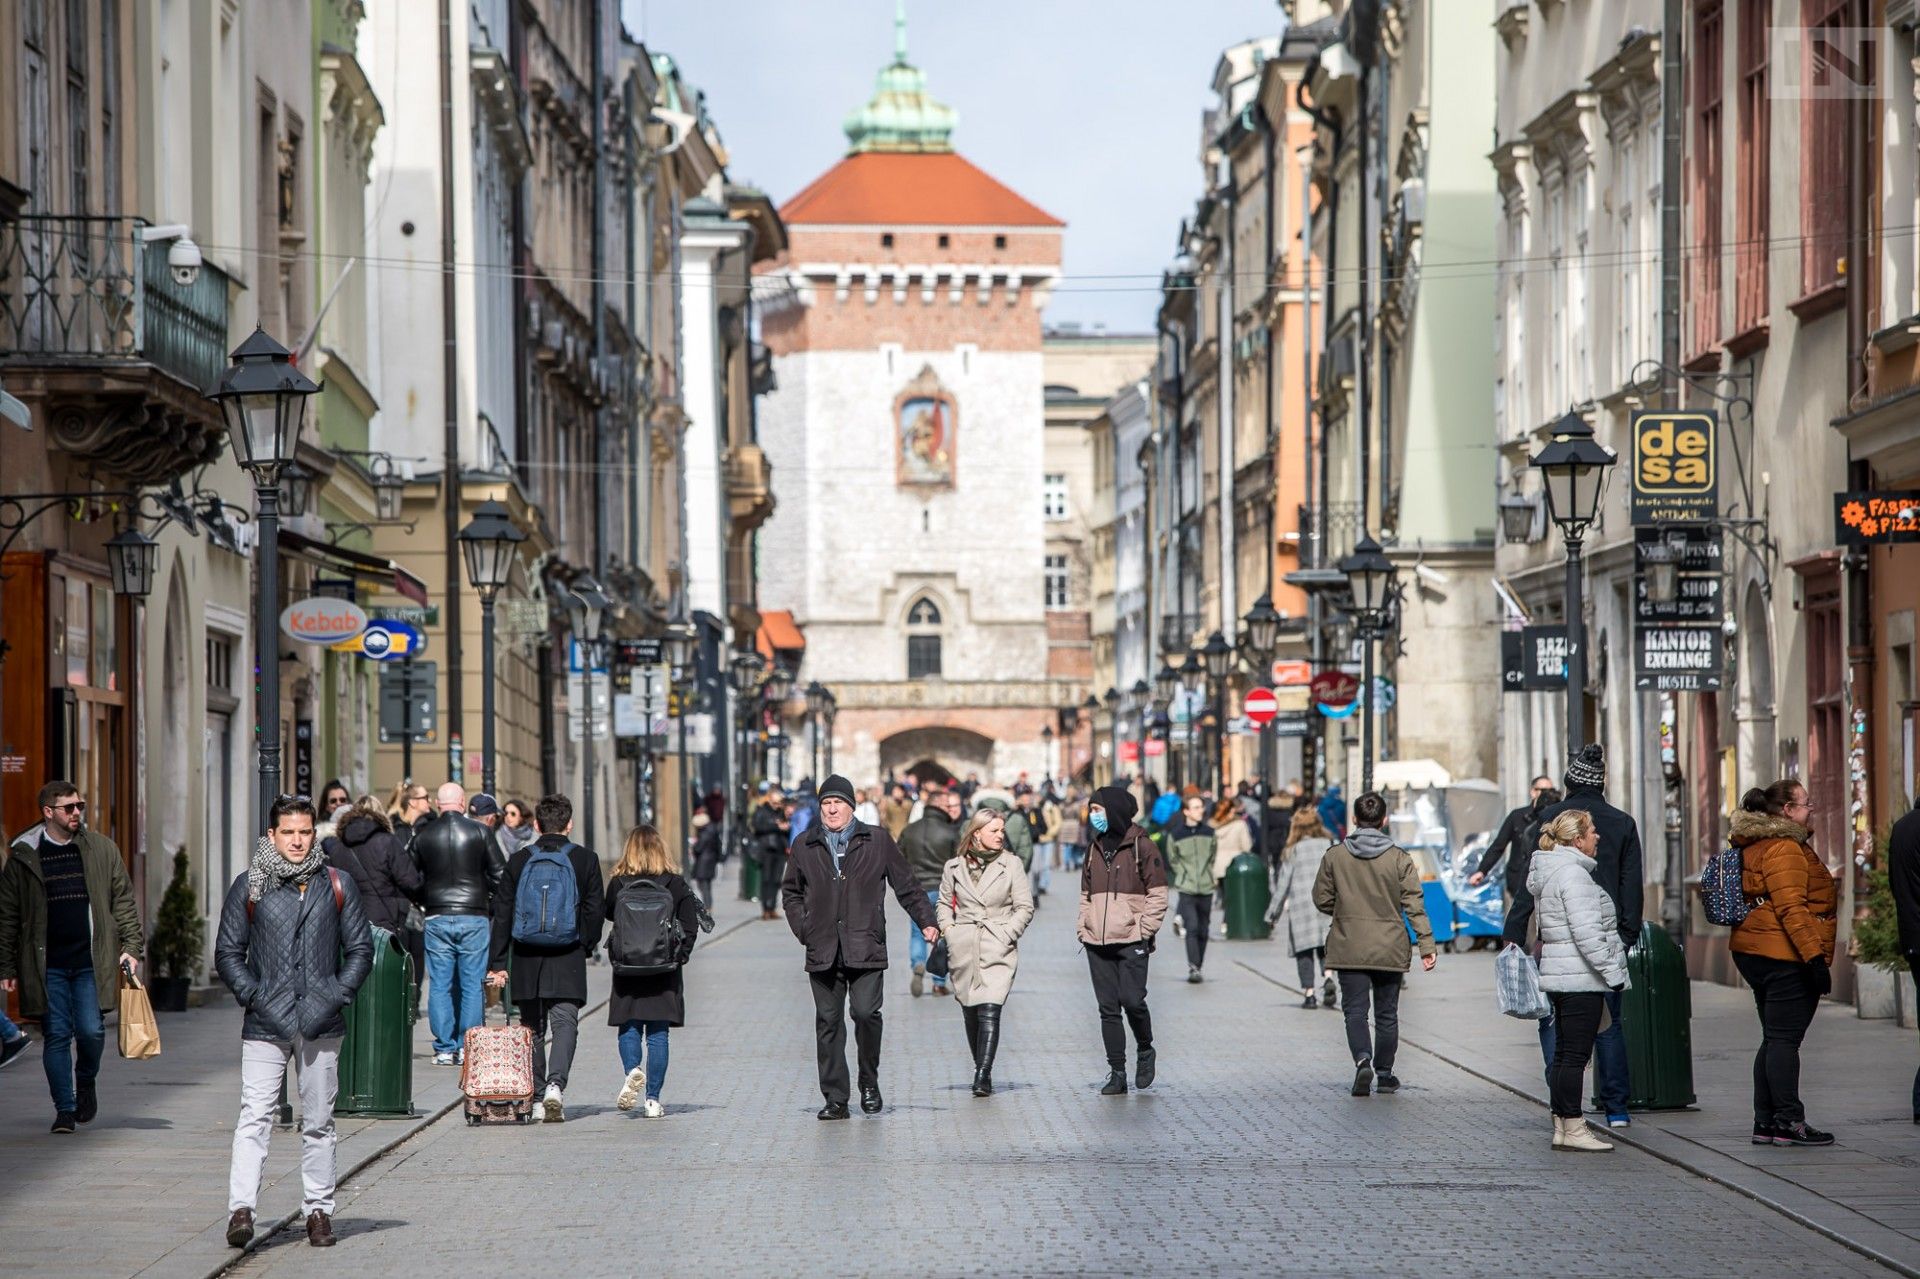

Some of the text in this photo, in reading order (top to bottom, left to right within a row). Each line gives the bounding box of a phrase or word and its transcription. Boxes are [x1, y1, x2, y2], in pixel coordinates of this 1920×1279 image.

[1640, 421, 1708, 457] de
[1641, 457, 1707, 484] sa
[1880, 517, 1920, 534] PIZZ
[1682, 580, 1719, 597] SHOP
[290, 608, 360, 634] Kebab
[1645, 630, 1712, 651] KANTOR
[1536, 656, 1564, 675] PUB
[1644, 651, 1712, 669] EXCHANGE
[1657, 675, 1700, 690] HOSTEL
